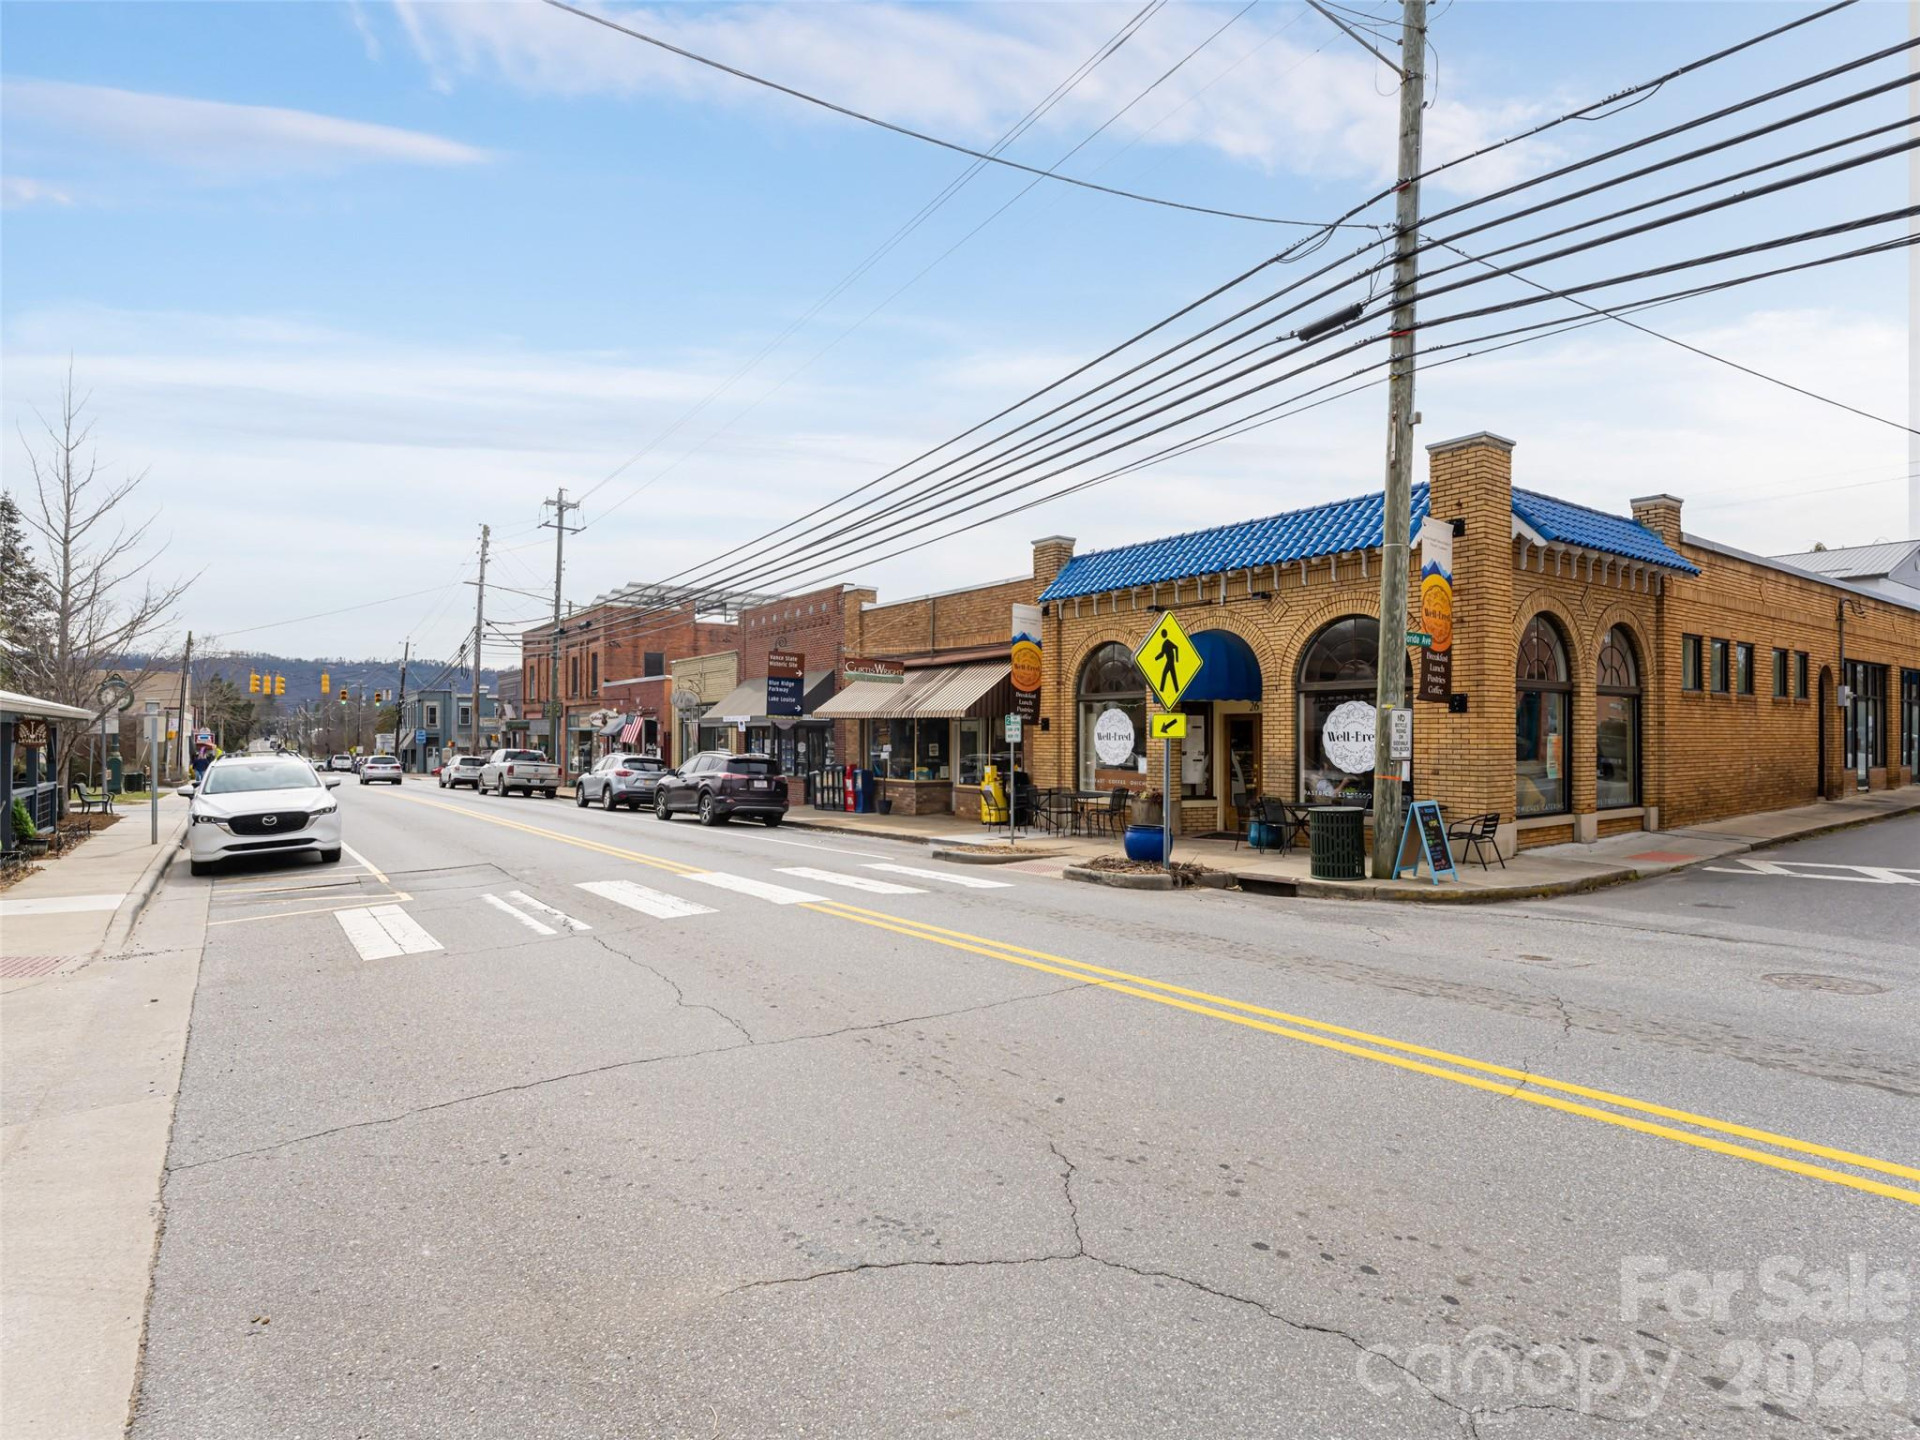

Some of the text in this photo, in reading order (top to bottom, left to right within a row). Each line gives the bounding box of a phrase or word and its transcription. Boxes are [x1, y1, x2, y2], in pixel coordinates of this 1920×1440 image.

[1406, 634, 1431, 645] orida Ave
[1427, 651, 1448, 662] Breakfast
[1430, 663, 1445, 673] Lunch
[1428, 674, 1446, 684] Pastries
[1428, 686, 1444, 695] Coffee
[1249, 702, 1259, 711] 26
[1397, 714, 1406, 722] NO
[1097, 732, 1131, 740] Well-Bred
[1328, 731, 1374, 742] Well-Bre
